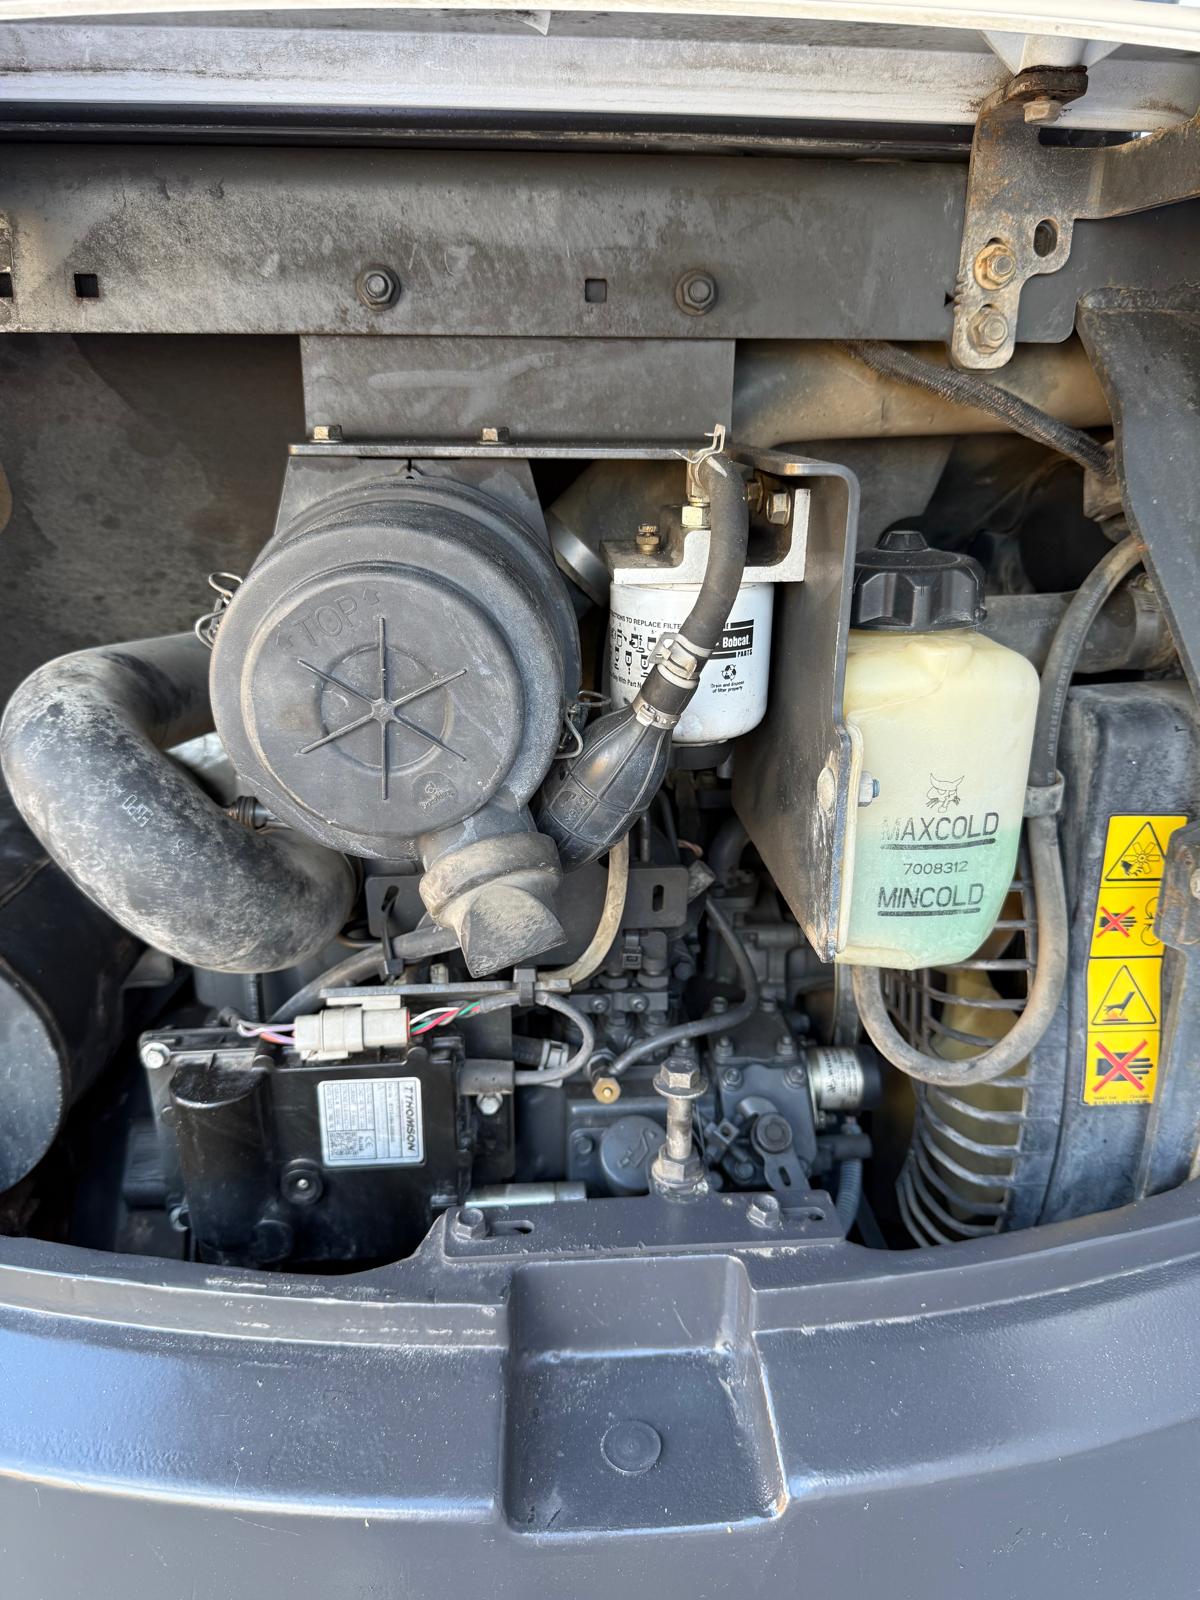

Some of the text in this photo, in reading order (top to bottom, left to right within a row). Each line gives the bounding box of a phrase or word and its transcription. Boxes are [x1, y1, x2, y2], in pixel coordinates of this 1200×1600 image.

[293, 595, 358, 647] TOP
[626, 616, 633, 624] TO
[633, 618, 662, 628] REPLACE
[663, 622, 682, 630] FILTE
[722, 634, 750, 648] Bobcat
[737, 649, 752, 657] PARTS
[881, 812, 999, 841] MAXCOLD
[903, 860, 969, 875] 7008312
[877, 883, 985, 909] MINCOLD
